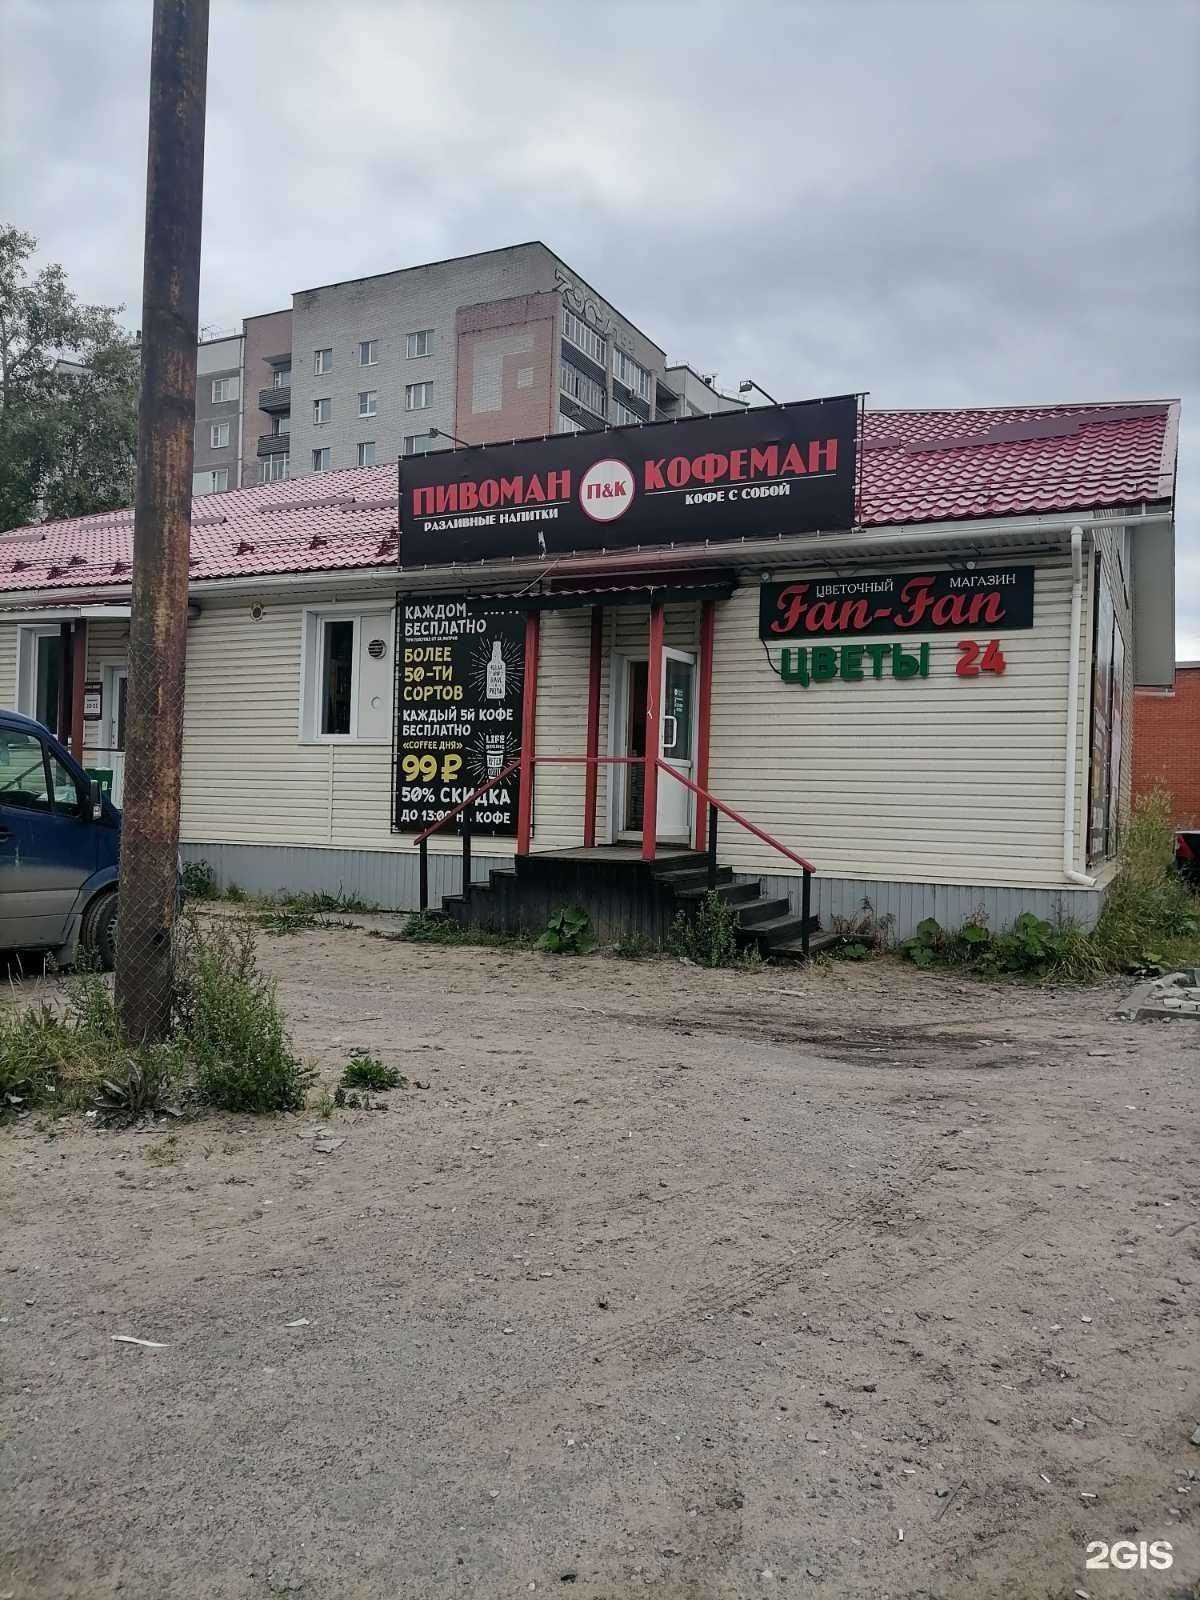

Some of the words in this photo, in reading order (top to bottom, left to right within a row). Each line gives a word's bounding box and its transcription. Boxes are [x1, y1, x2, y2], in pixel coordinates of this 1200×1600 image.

[644, 439, 838, 490] КОФЕМАН
[412, 469, 571, 516] ПИВОМАН
[587, 481, 627, 499] П&К
[685, 490, 725, 505] КОФЕ
[729, 490, 738, 501] С
[742, 482, 790, 500] СОБОЙ
[424, 514, 496, 532] РАЗЛИВНЫЕ
[499, 508, 559, 524] НАПИТКИ
[816, 578, 894, 598] ЦВЕТОЧНЫЙ
[949, 573, 1016, 588] МАГАЗИН
[405, 602, 473, 619] КАЖДОМ
[770, 576, 1006, 633] Fan-Fan
[404, 619, 487, 636] БЕСПЛАТНО
[404, 647, 452, 662] БОЛЕЕ
[781, 642, 930, 687] ЦВЕТЫ
[956, 639, 1006, 677] 24
[404, 665, 453, 682] 50-ТИ
[403, 685, 463, 701] СОРТОВ
[403, 706, 457, 722] КАЖДЫЙ
[479, 708, 513, 721] КОФЕ
[402, 724, 471, 736] БЕСПЛАТНО
[401, 786, 435, 802] 50%
[440, 787, 511, 806] СКИДКА
[401, 809, 418, 822] ДО
[476, 811, 511, 824] КОФЕ
